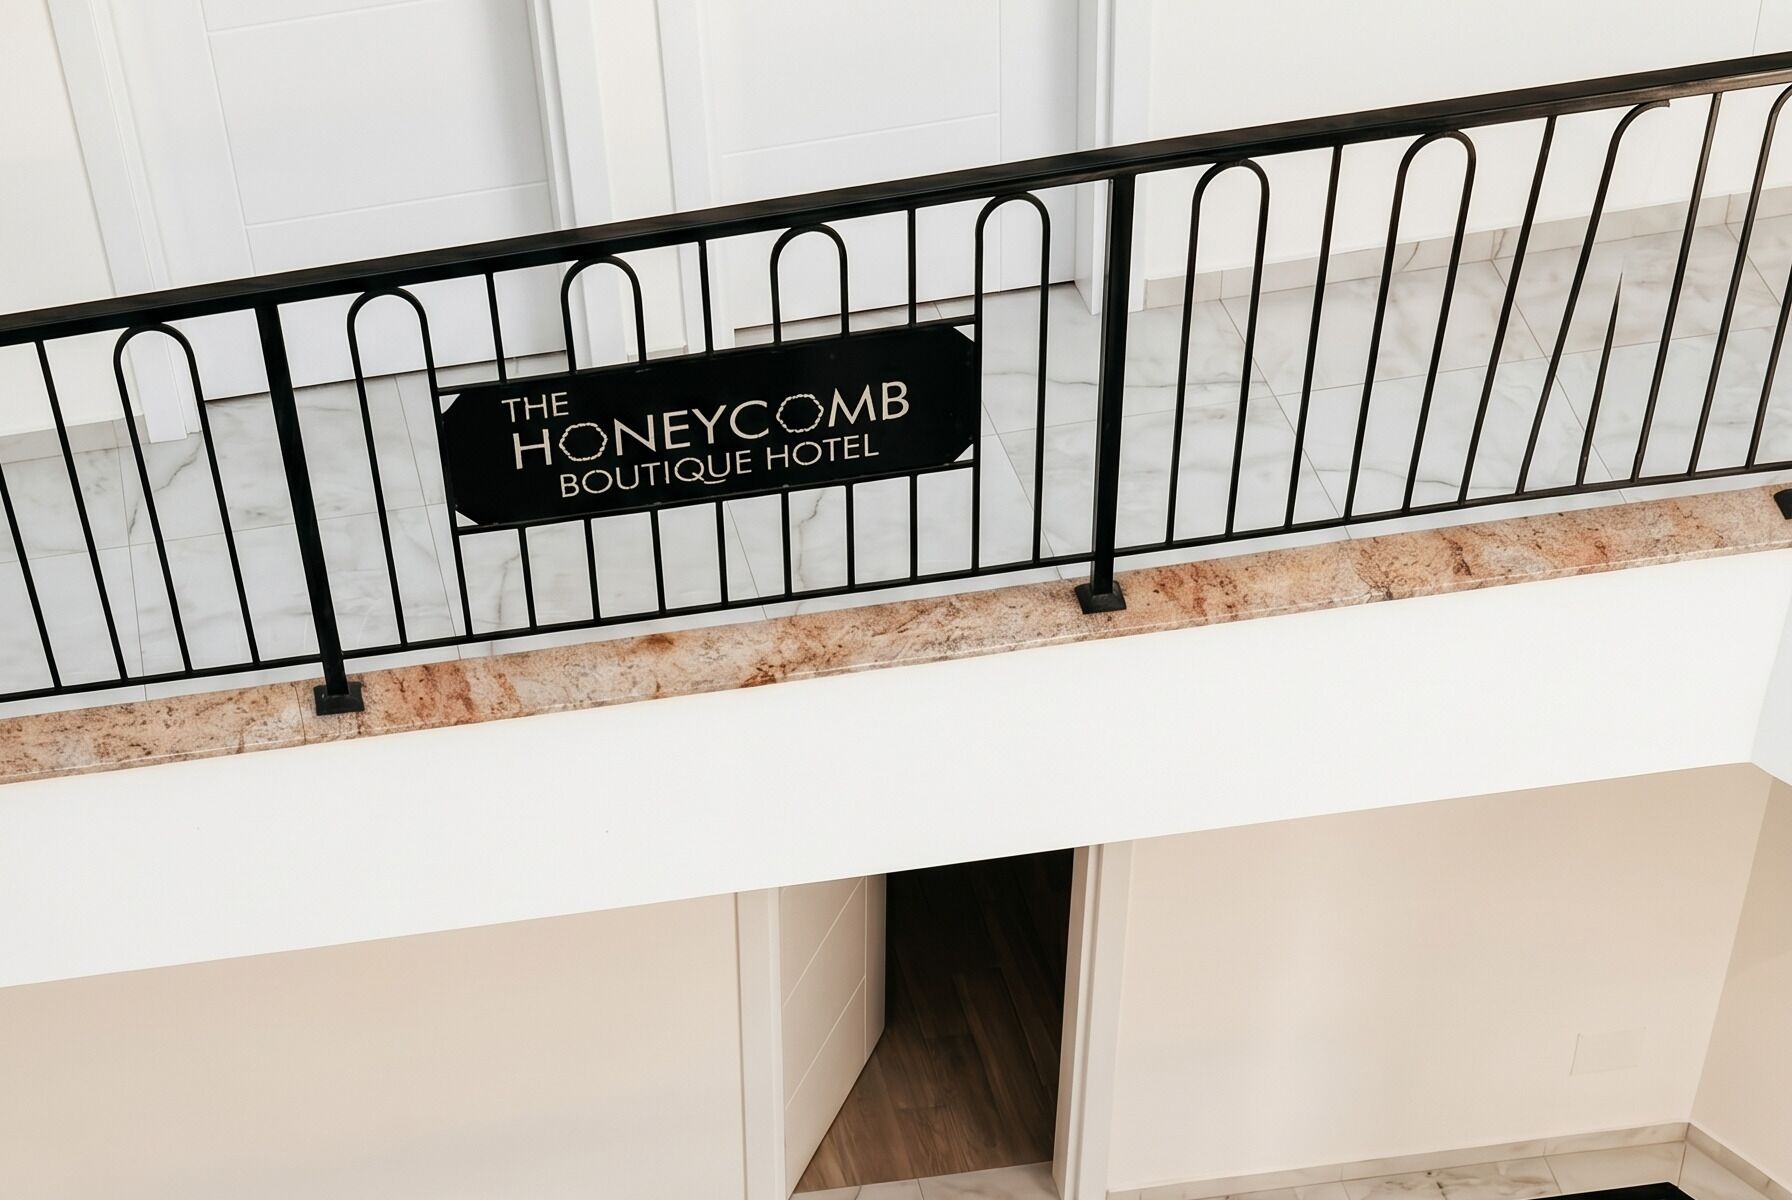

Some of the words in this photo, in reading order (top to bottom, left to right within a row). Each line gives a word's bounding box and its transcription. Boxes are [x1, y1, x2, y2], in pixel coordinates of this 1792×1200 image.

[501, 391, 569, 423] THE
[512, 381, 911, 469] HONEYCOMB
[560, 450, 753, 498] BOUTIQUE
[766, 433, 880, 470] HOTEL
